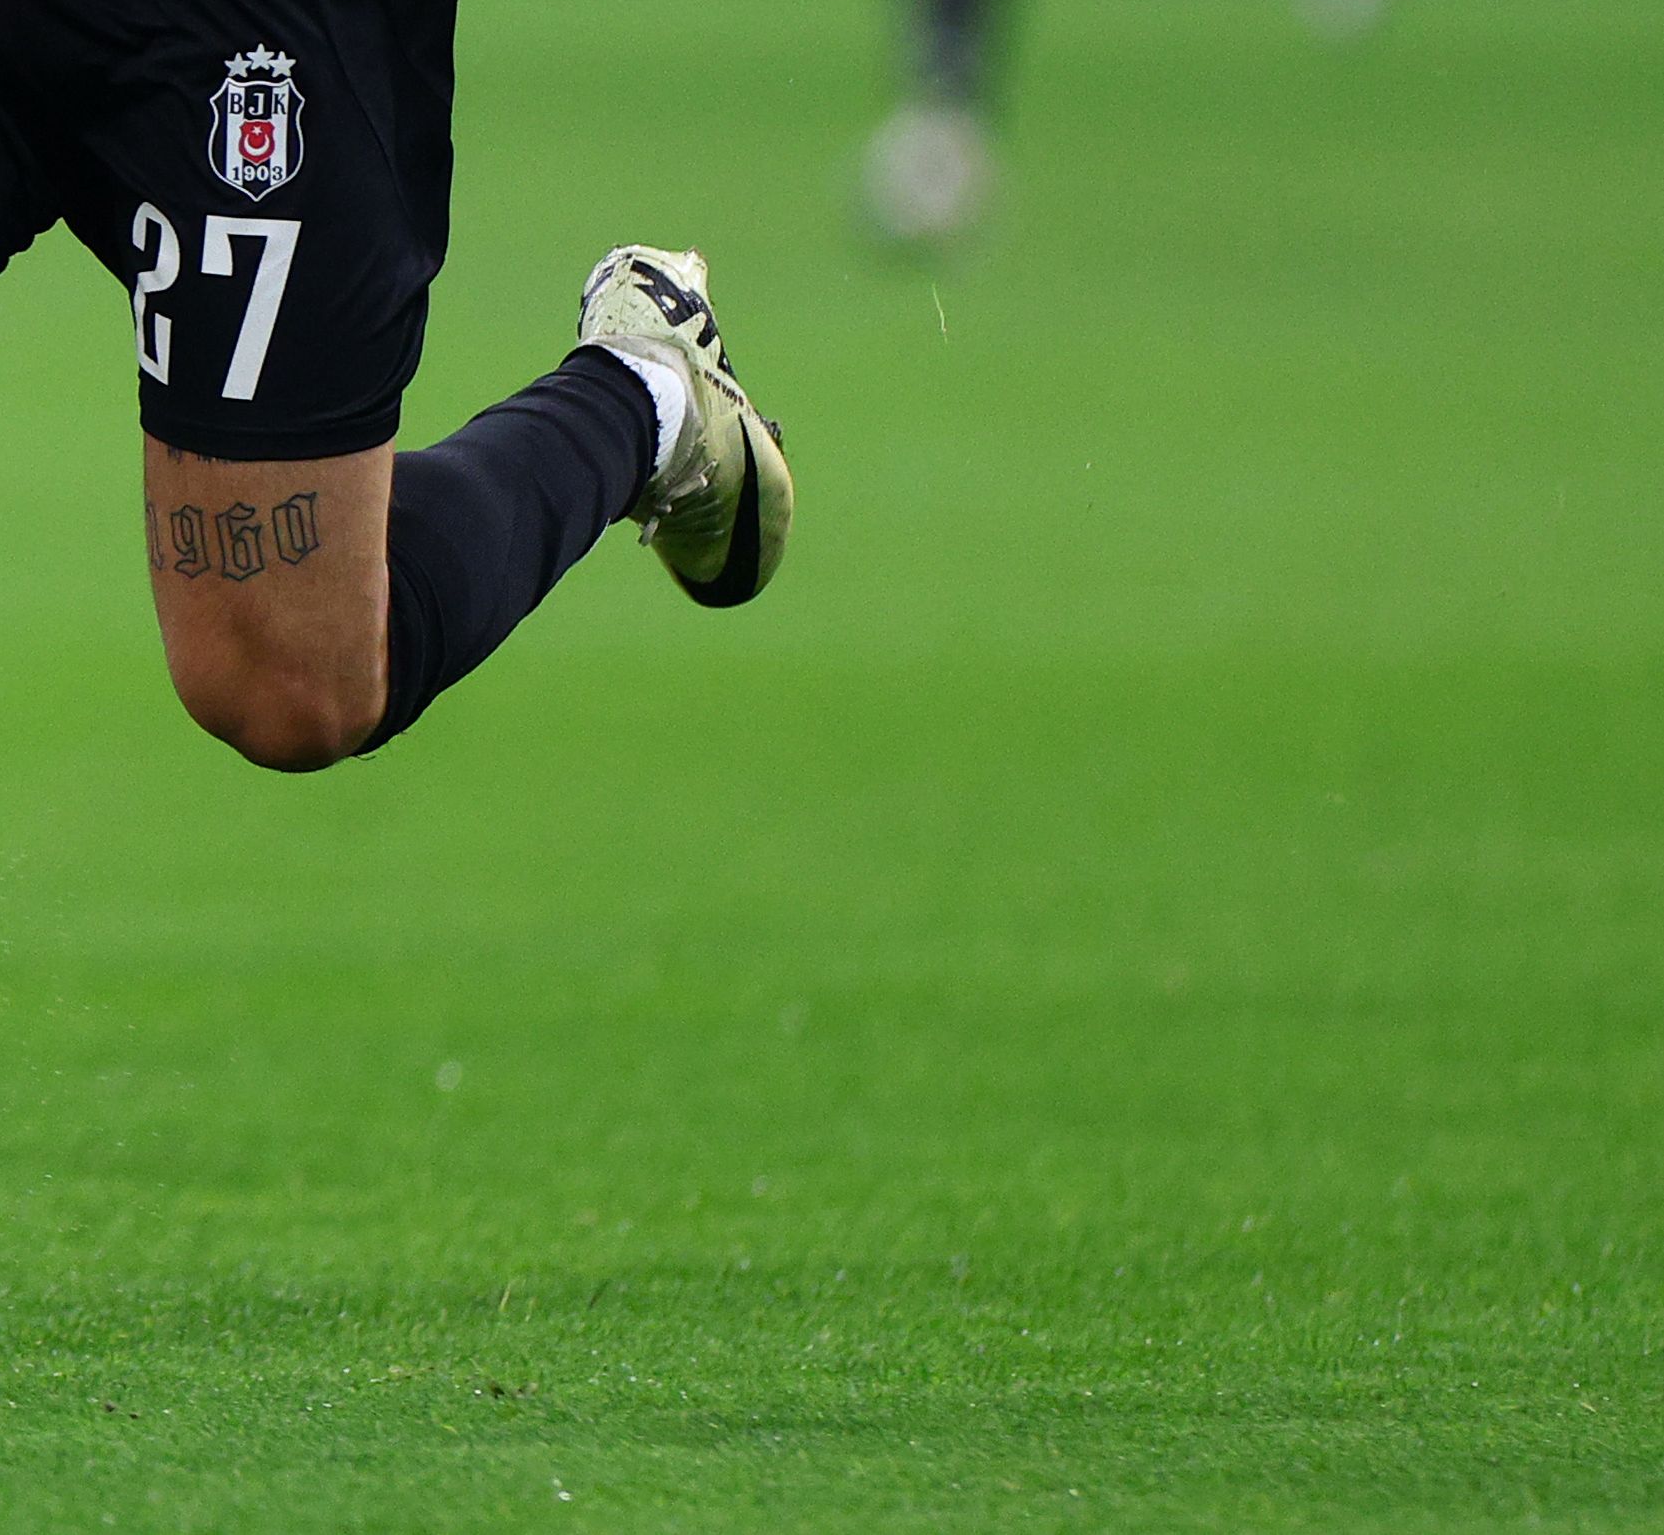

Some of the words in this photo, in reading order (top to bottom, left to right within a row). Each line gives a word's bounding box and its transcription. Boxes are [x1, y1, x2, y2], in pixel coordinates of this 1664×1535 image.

[229, 93, 287, 115] BJK
[232, 166, 284, 182] 1903
[132, 201, 302, 401] 27
